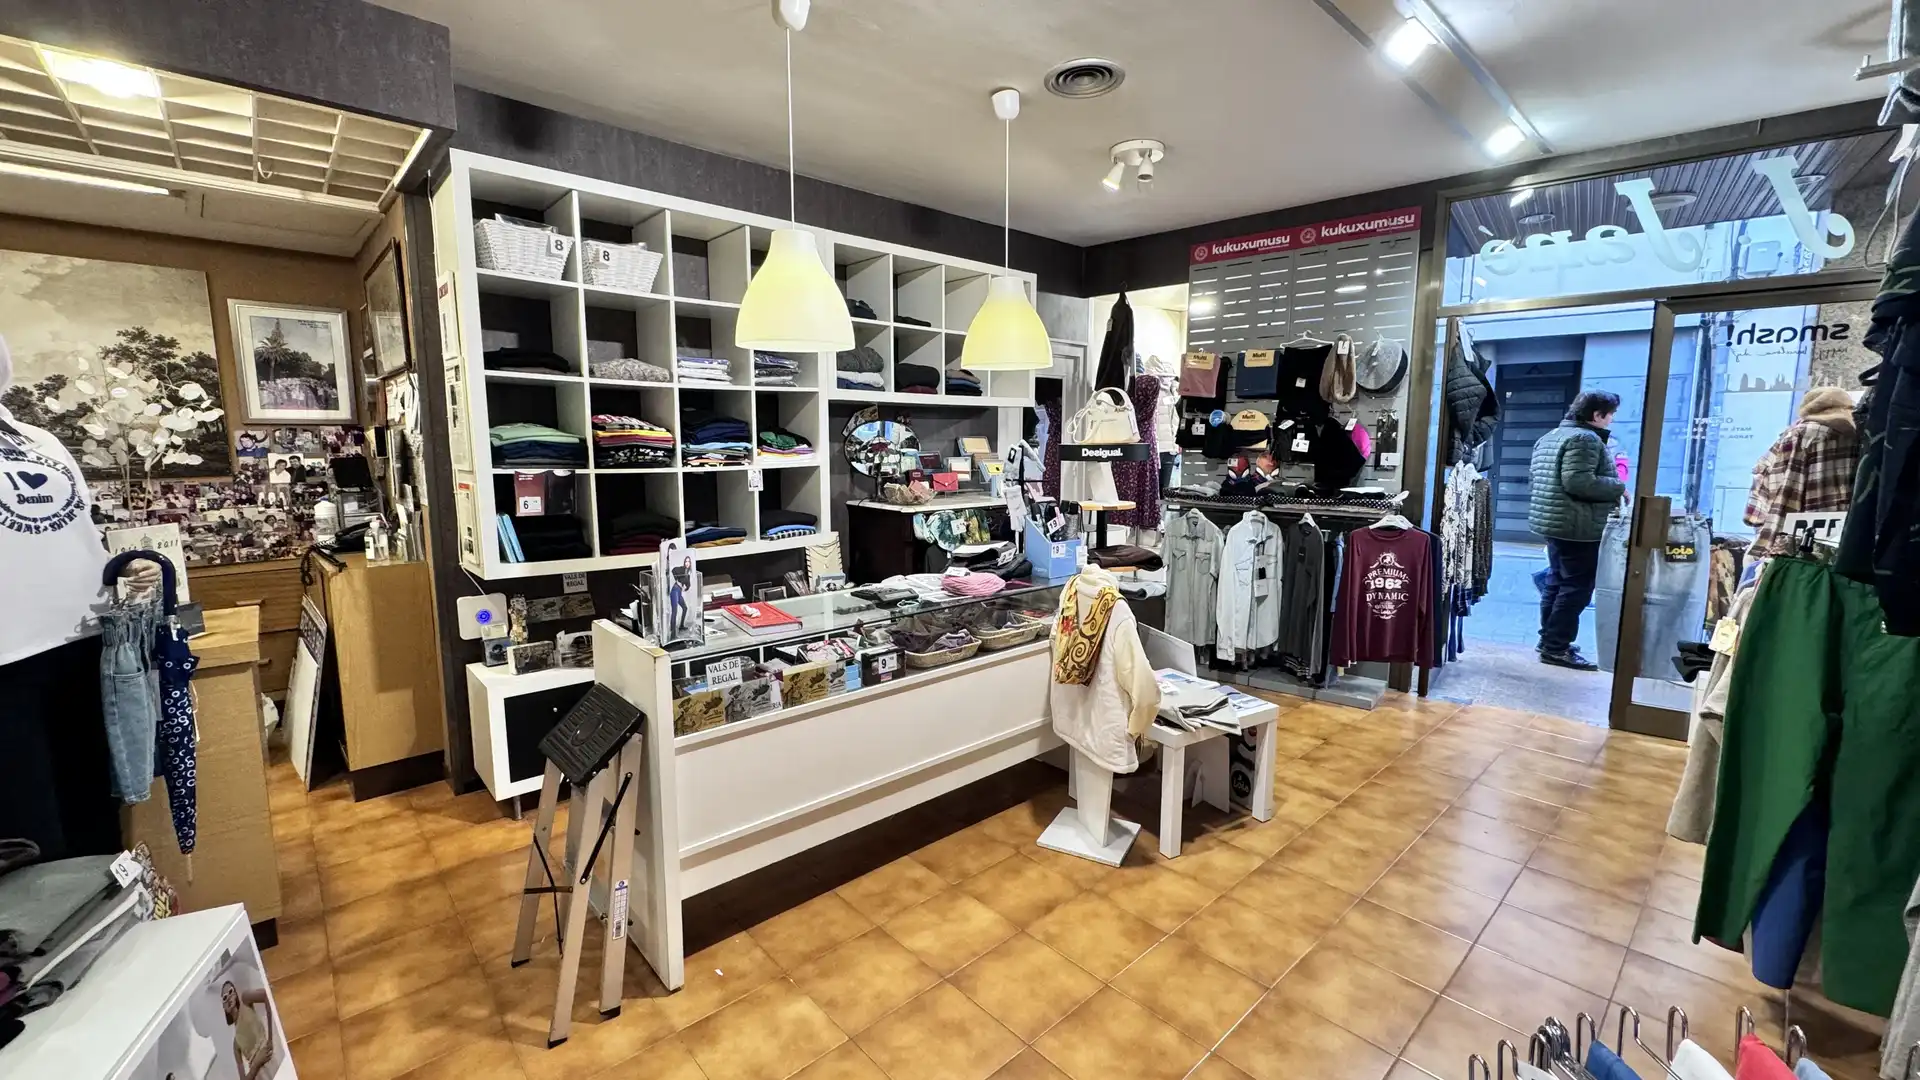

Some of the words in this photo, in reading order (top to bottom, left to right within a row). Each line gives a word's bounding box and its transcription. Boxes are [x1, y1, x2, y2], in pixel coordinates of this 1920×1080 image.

[1321, 214, 1415, 237] kukuxumusu
[554, 239, 564, 251] 8
[1212, 234, 1290, 255] kukuxumusu
[602, 250, 610, 261] 8
[16, 493, 54, 505] Denim
[523, 500, 529, 510] 6
[1049, 519, 1058, 529] 19
[1665, 545, 1693, 555] Lois
[1367, 567, 1407, 580] PREMIUM
[1370, 577, 1402, 590] 1962
[1366, 592, 1409, 602] DYNAMIC
[707, 662, 728, 674] VALS
[728, 659, 740, 670] DE
[881, 658, 887, 669] 9
[711, 671, 739, 685] REGAL
[115, 863, 129, 881] 19
